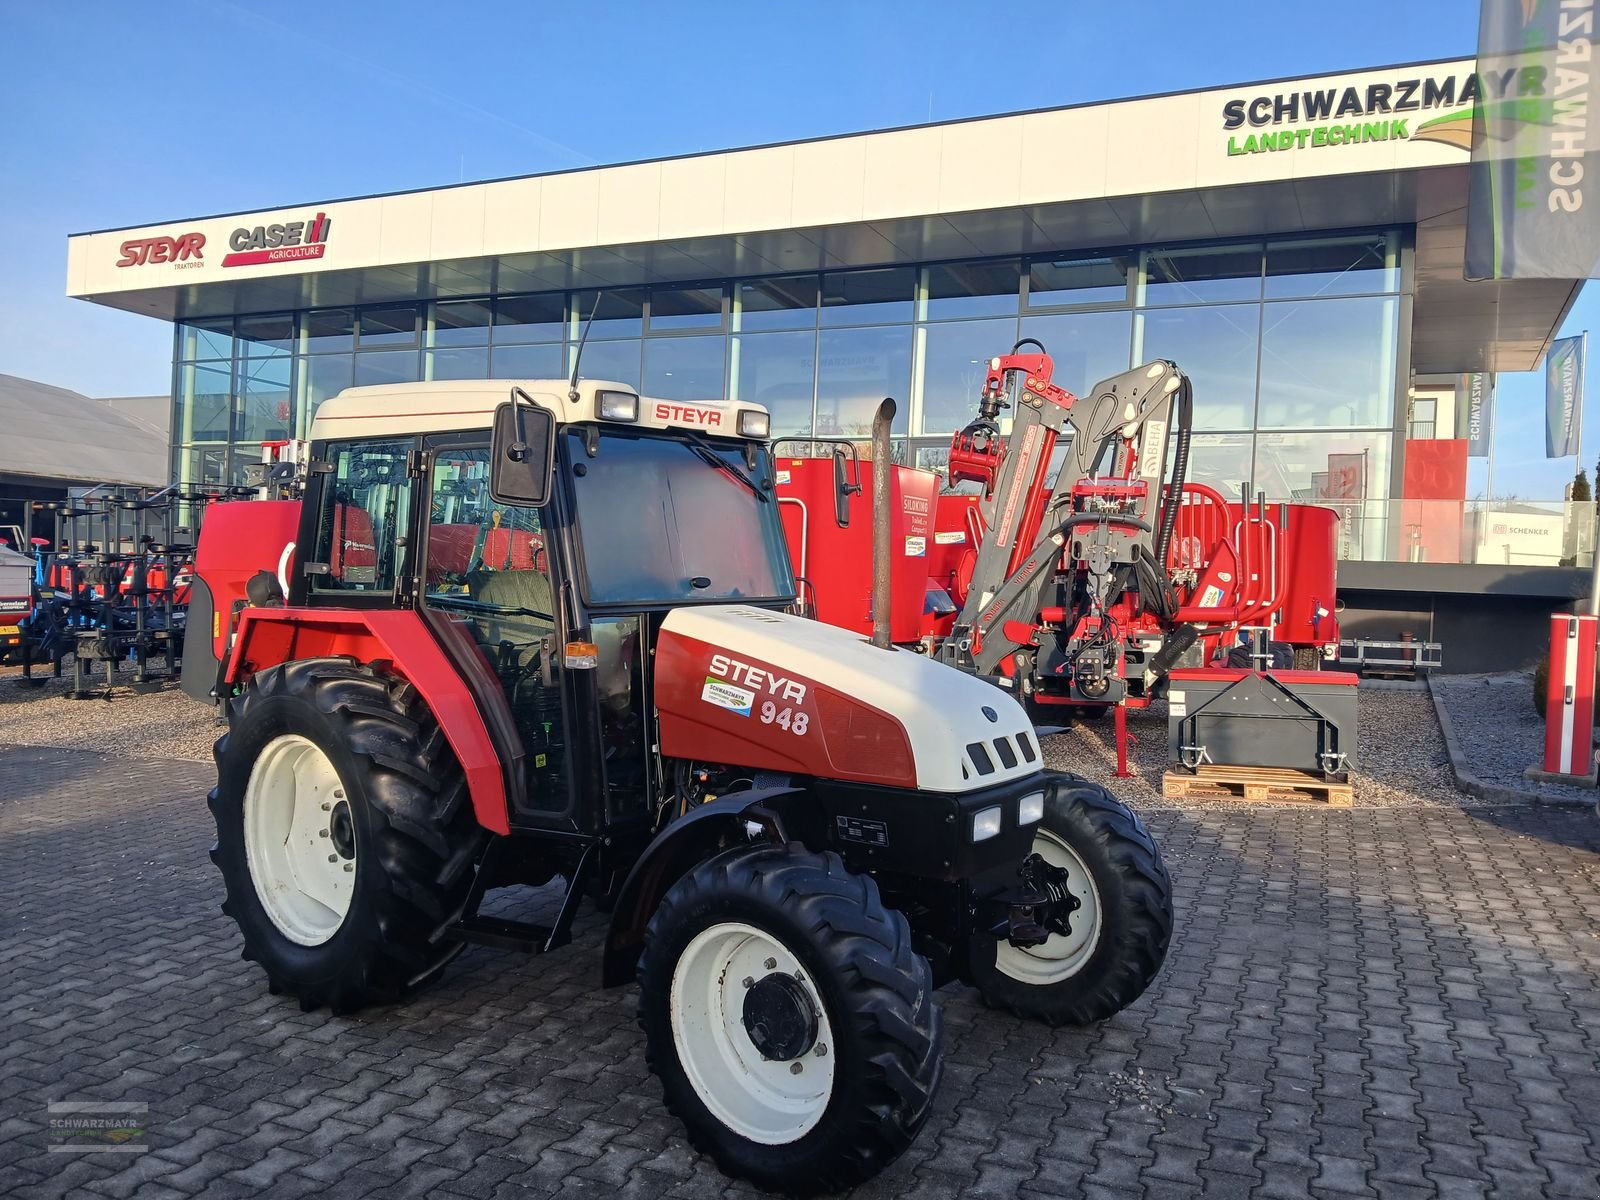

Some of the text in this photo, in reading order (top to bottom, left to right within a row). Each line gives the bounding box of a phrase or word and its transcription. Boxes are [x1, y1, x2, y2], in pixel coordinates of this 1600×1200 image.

[1227, 118, 1410, 156] LANDTECHNIK
[116, 232, 206, 267] STEYR
[228, 222, 304, 252] CASE
[174, 261, 205, 271] TRAKTOREN
[268, 246, 320, 260] AGRICULTURE
[655, 402, 722, 427] STEYR
[1147, 423, 1161, 455] BEHA
[1508, 526, 1550, 537] SCHENKER
[709, 654, 807, 705] STEYR
[759, 700, 810, 737] 948
